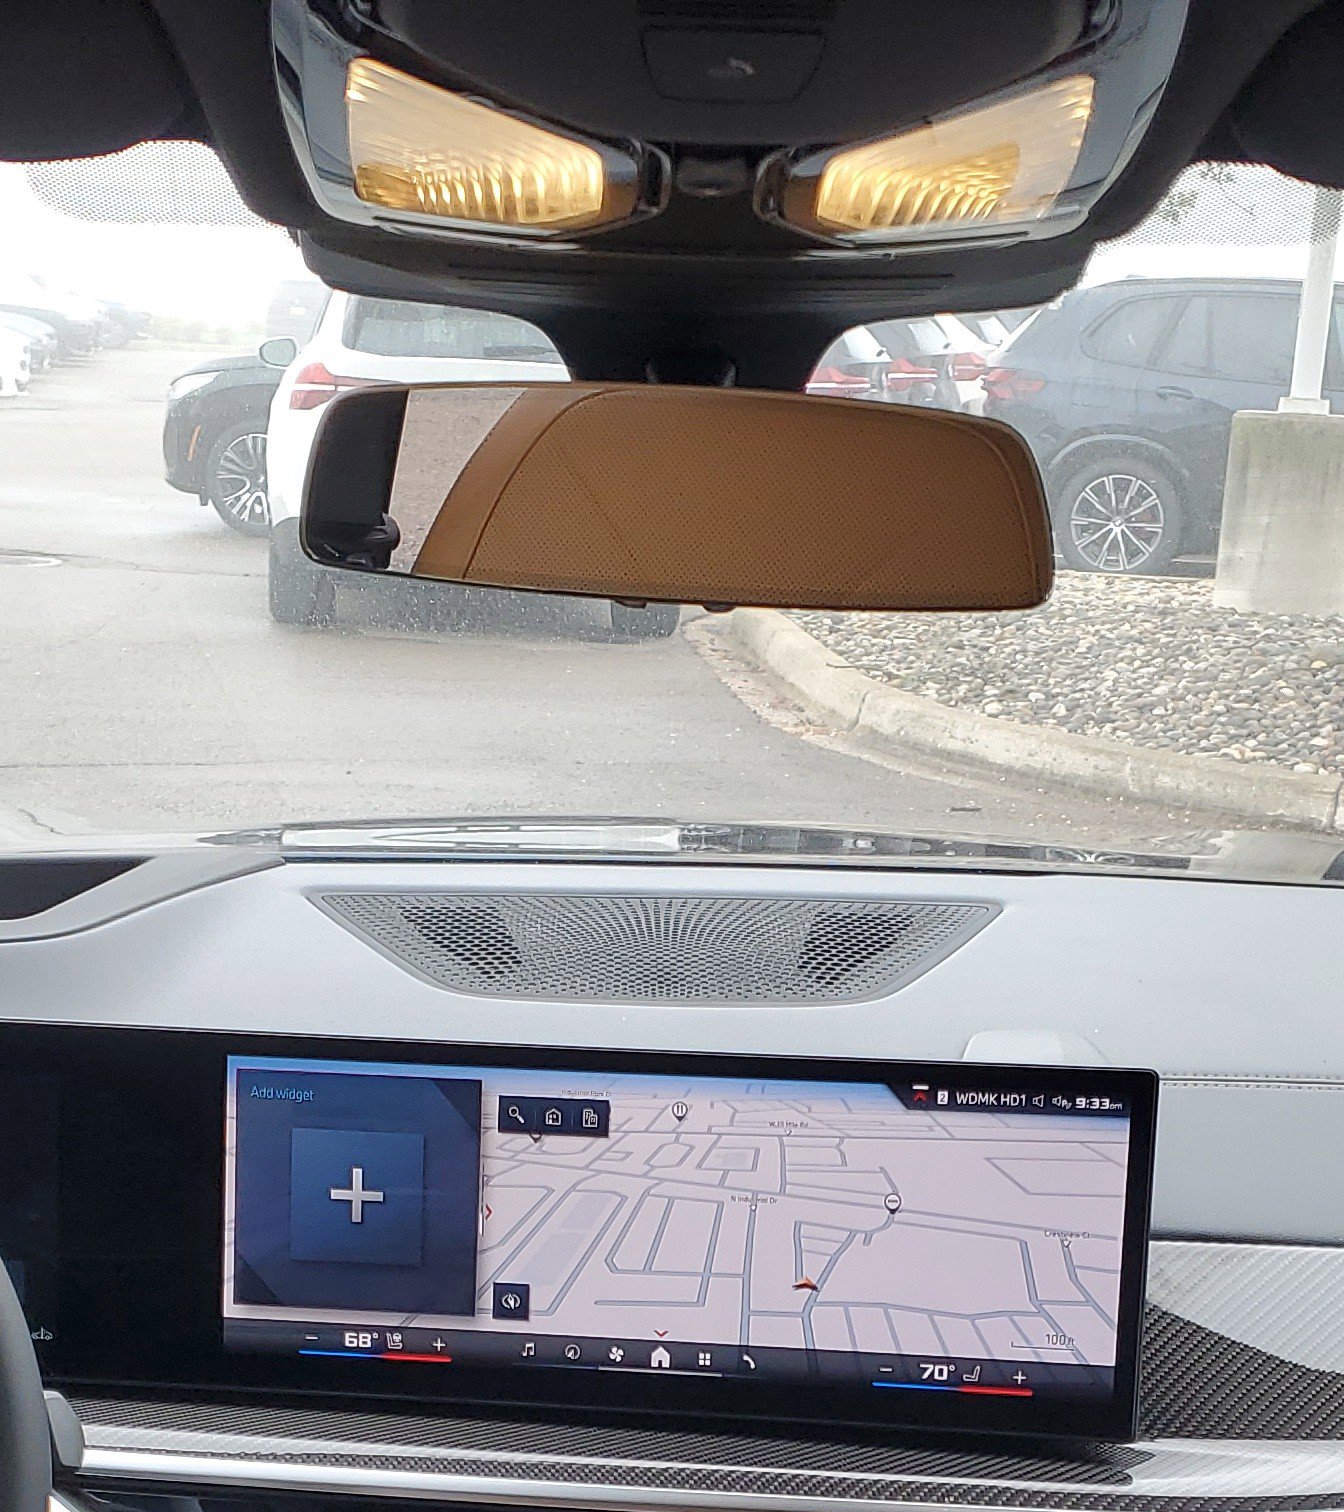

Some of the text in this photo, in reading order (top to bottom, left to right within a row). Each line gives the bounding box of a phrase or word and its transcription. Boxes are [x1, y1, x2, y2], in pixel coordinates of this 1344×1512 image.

[250, 1086, 314, 1102] Add widget
[956, 1092, 998, 1106] WDMK
[1000, 1093, 1026, 1107] HD1
[1045, 1333, 1066, 1346] 100
